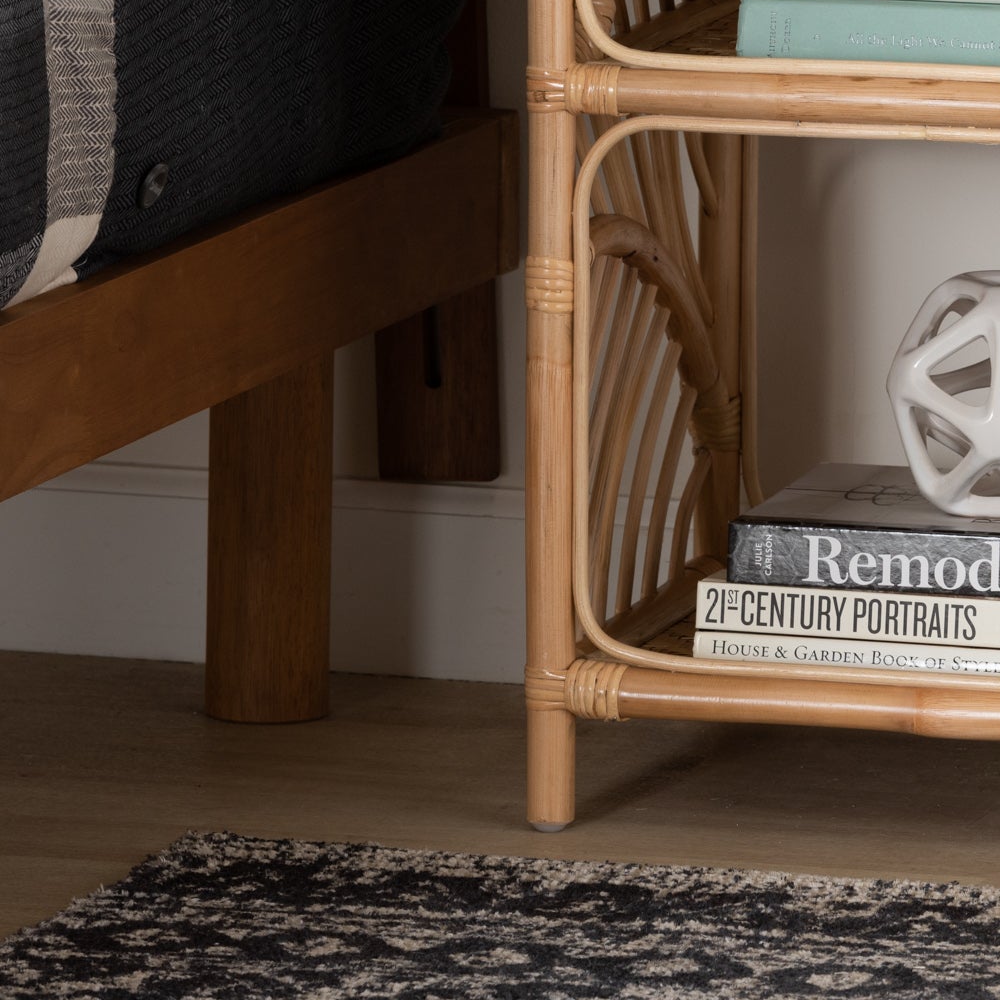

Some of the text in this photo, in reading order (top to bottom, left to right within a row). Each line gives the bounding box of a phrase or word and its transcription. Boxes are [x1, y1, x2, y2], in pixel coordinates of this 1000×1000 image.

[950, 37, 996, 51] Cannot
[755, 543, 763, 566] JULIE
[764, 534, 773, 576] CARLSON
[740, 590, 847, 632] CENTURY
[852, 597, 977, 641] PORTRAITS
[712, 639, 770, 657] HOUSE
[774, 645, 788, 659] &
[794, 645, 864, 664] GARDEN
[872, 650, 919, 668] BOOK
[924, 657, 946, 669] OF
